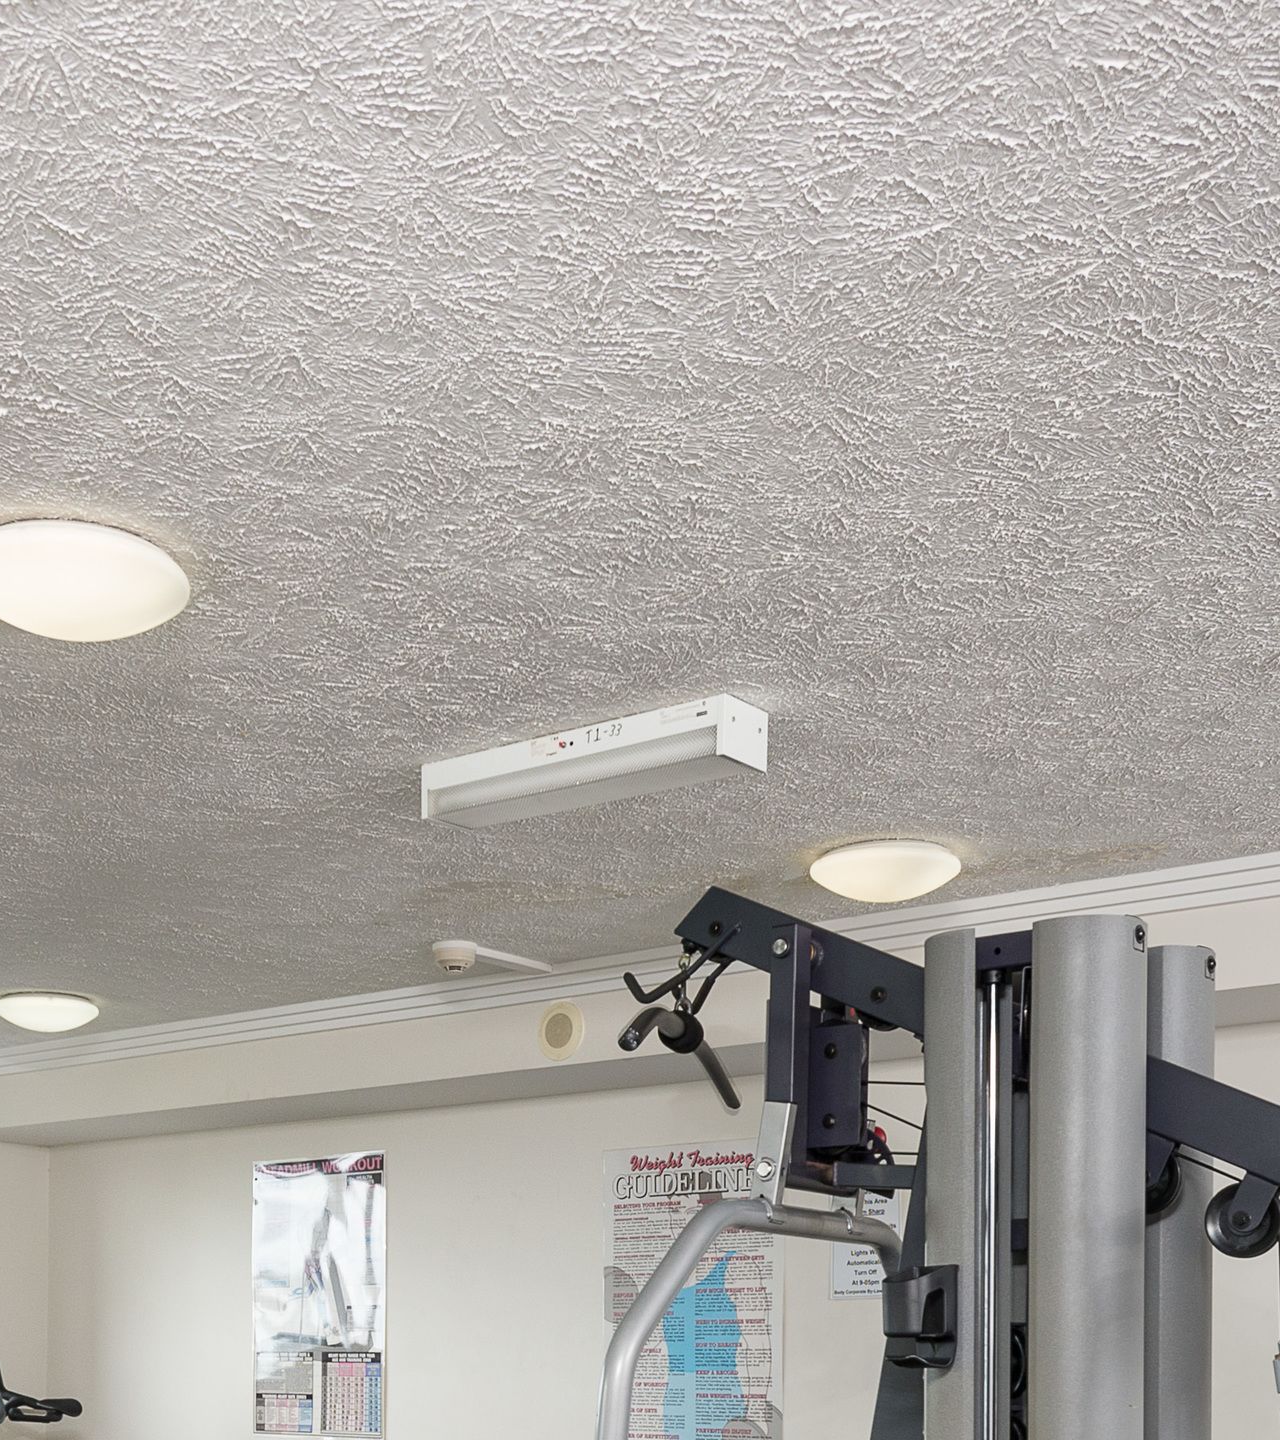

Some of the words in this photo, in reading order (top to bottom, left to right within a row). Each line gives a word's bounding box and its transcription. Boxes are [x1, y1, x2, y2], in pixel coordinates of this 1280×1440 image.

[629, 1152, 684, 1175] Weight
[686, 1150, 756, 1168] Training
[612, 1166, 754, 1200] GUIDELINE
[850, 1249, 869, 1257] Lights
